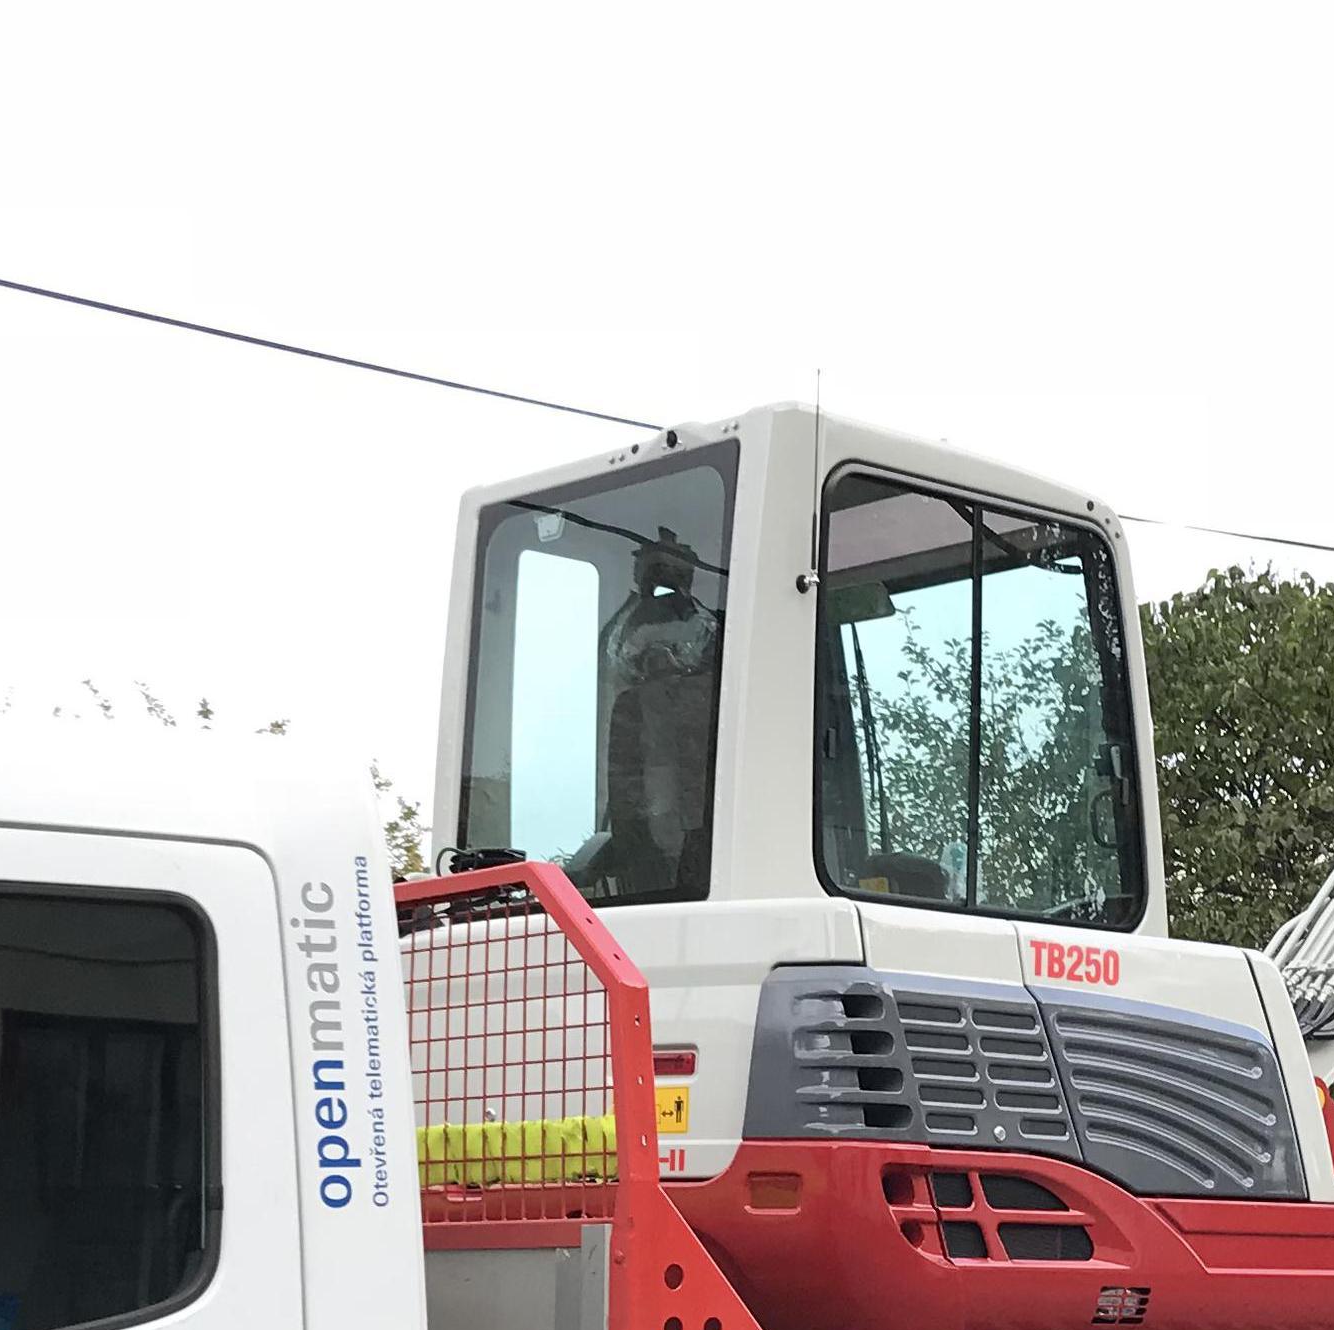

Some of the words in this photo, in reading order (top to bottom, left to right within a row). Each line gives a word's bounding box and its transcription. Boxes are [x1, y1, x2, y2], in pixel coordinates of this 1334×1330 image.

[353, 855, 378, 964] platforma
[1029, 940, 1121, 986] TB250
[290, 881, 361, 1208] openmatic
[359, 970, 382, 1100] telematická
[367, 1107, 390, 1208] Otevřená
